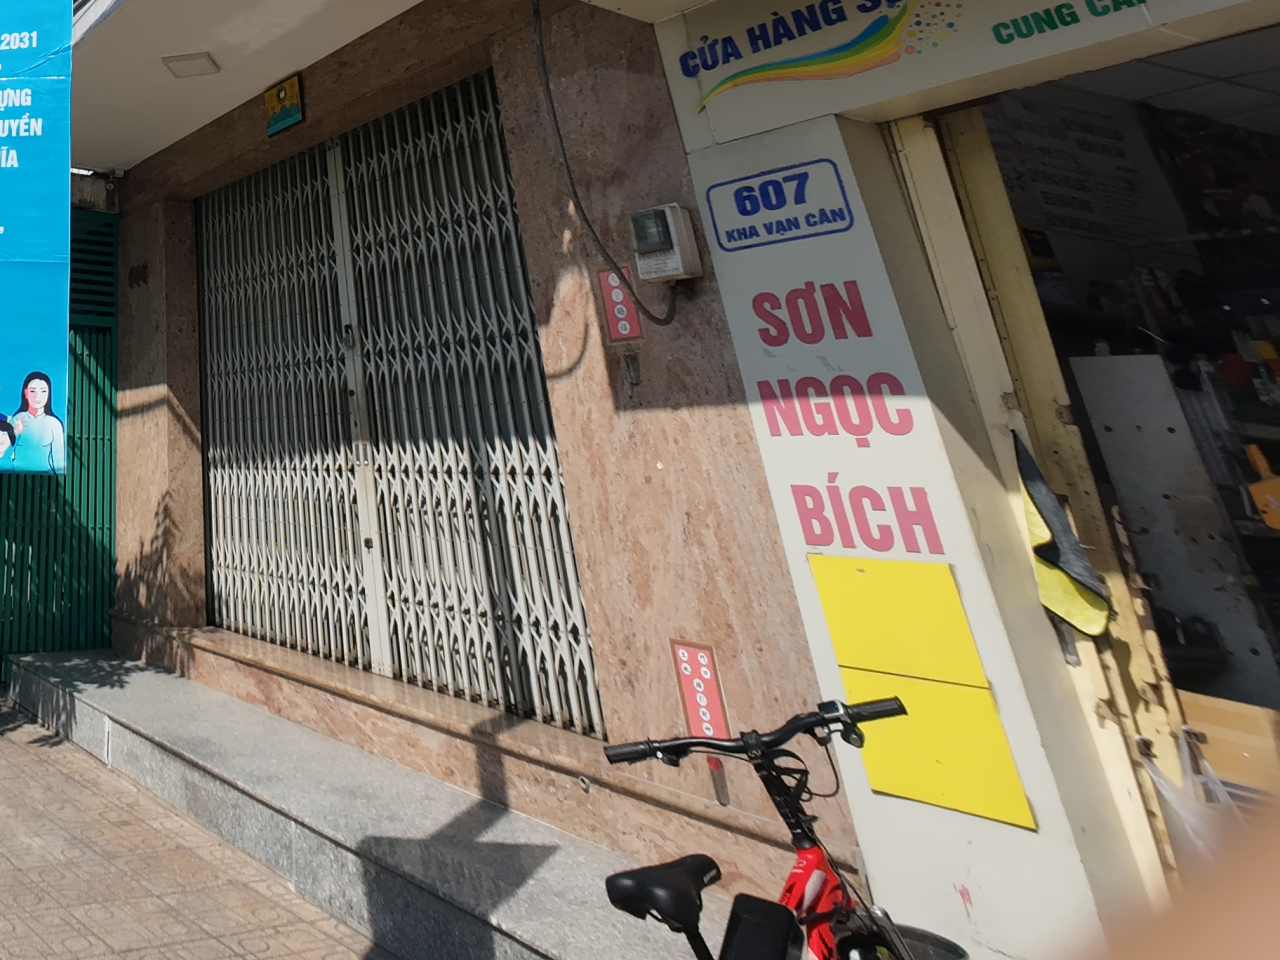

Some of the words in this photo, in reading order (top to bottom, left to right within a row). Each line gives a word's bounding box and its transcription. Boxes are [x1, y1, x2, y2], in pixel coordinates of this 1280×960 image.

[0, 31, 38, 50] 2031
[991, 2, 1080, 45] CUNG
[678, 35, 743, 78] CỬA
[733, 171, 809, 216] 607
[725, 225, 760, 243] KHA
[763, 216, 800, 235] VẠN
[804, 207, 847, 227] CÂN
[751, 279, 874, 347] SƠN
[756, 372, 914, 448] NGỌC
[790, 471, 945, 555] BÍCH
